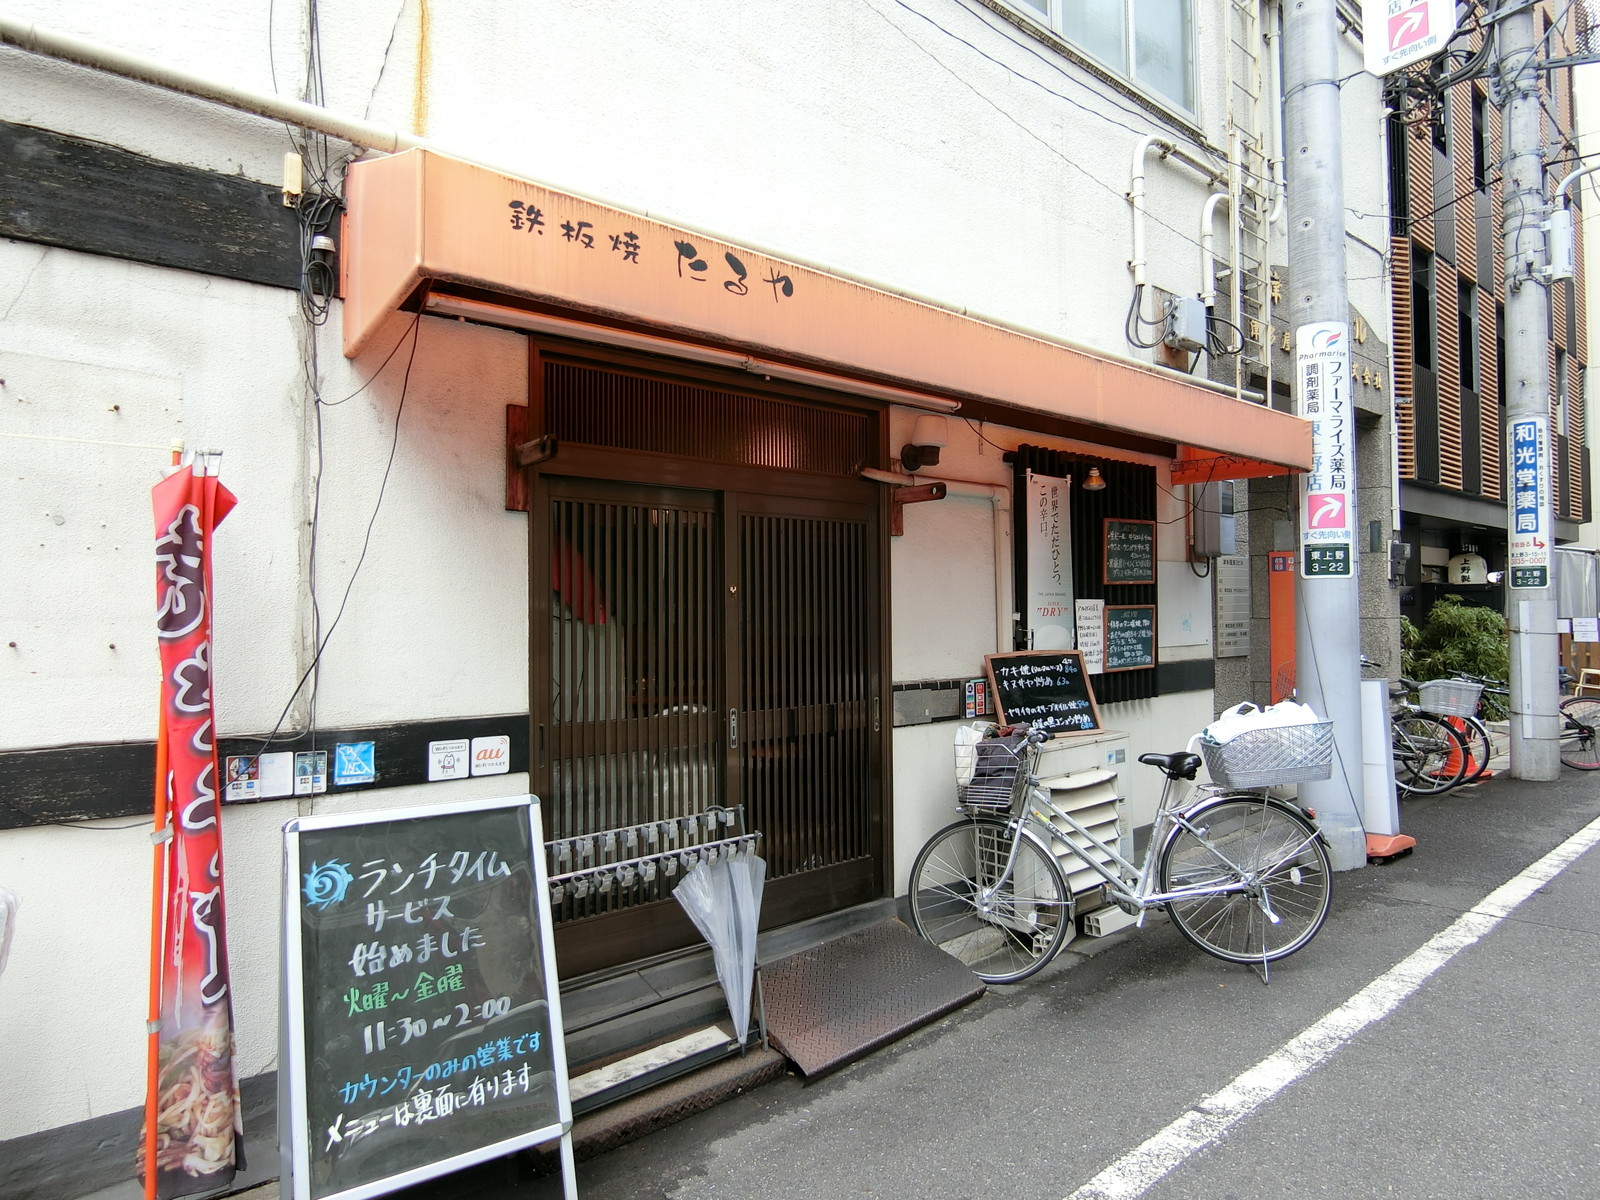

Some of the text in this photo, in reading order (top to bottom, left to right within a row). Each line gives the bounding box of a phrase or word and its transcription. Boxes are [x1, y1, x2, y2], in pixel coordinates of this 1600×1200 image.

[1382, 34, 1437, 65] すぐ先向い側
[509, 200, 794, 303] 鉄板焼 たるや
[1299, 349, 1347, 361] Pharmarise
[1305, 363, 1320, 415] 調剤薬局
[1329, 361, 1346, 490] ファーマライズ薬局
[1515, 424, 1537, 533] 和光堂薬局
[1038, 485, 1049, 538] この辛口。
[1050, 485, 1062, 586] 世界でただひとつ、
[1303, 530, 1351, 540] すぐ先向い側
[1311, 550, 1344, 561] 東上野
[1311, 562, 1344, 572] 3-22
[476, 748, 505, 761] au
[358, 851, 513, 898] ランチタイム
[366, 895, 455, 932] サービス
[349, 926, 487, 978] 始めました
[339, 1031, 542, 1104] カウンターのみの営業です
[325, 1062, 533, 1153] メニューは裏面に有ります
